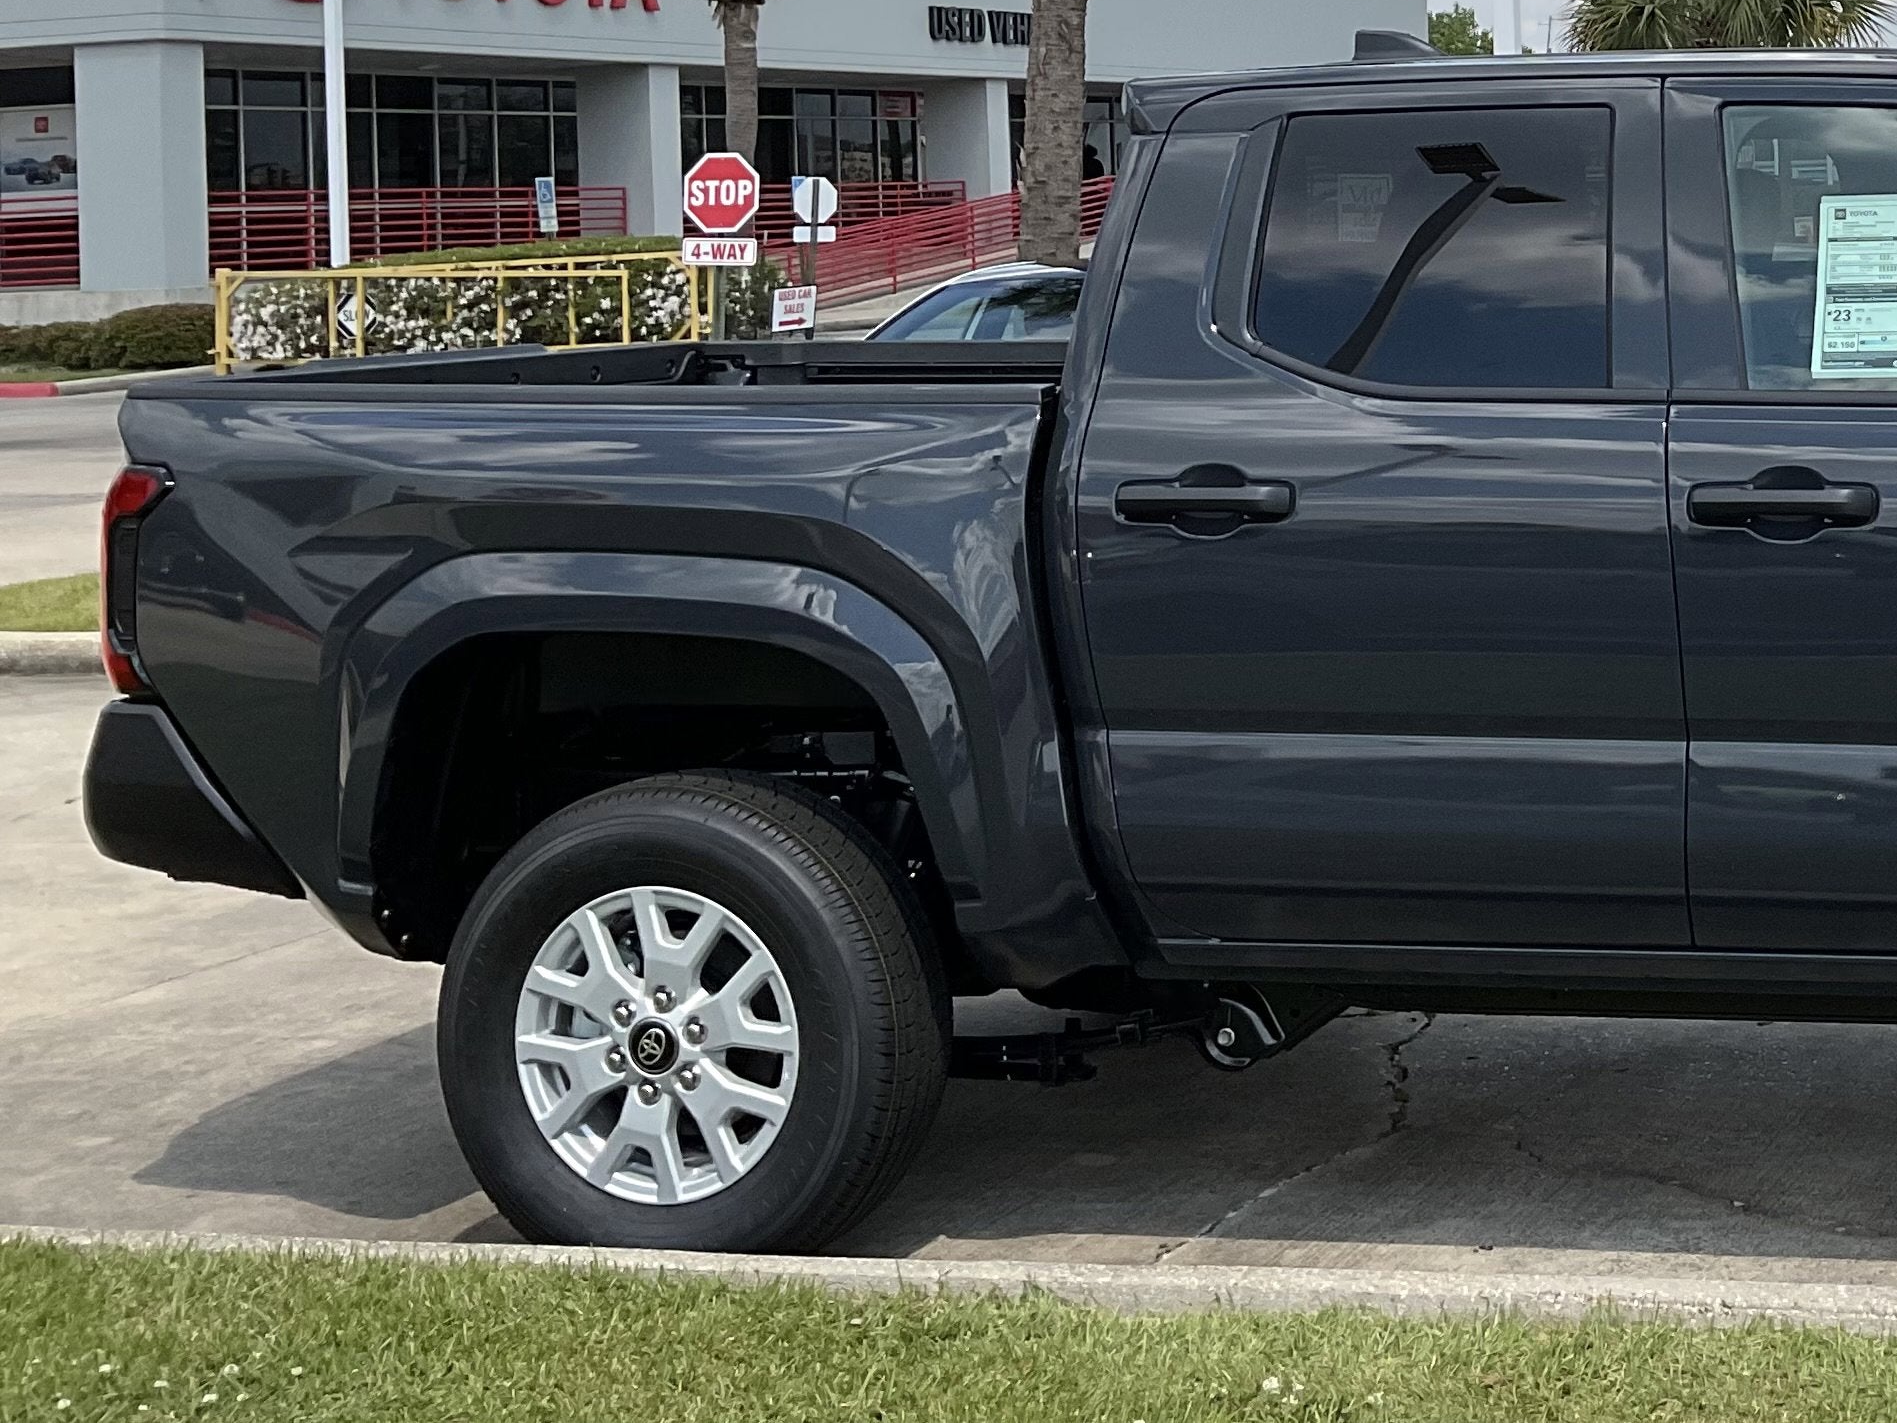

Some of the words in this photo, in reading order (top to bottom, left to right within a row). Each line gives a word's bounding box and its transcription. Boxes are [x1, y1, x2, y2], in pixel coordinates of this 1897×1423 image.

[928, 6, 986, 42] USED
[986, 10, 1032, 45] VEH
[690, 179, 753, 206] STOP
[690, 243, 748, 261] 4-WAY
[779, 289, 796, 301] USED
[798, 288, 812, 299] CAR
[1833, 309, 1851, 322] 23
